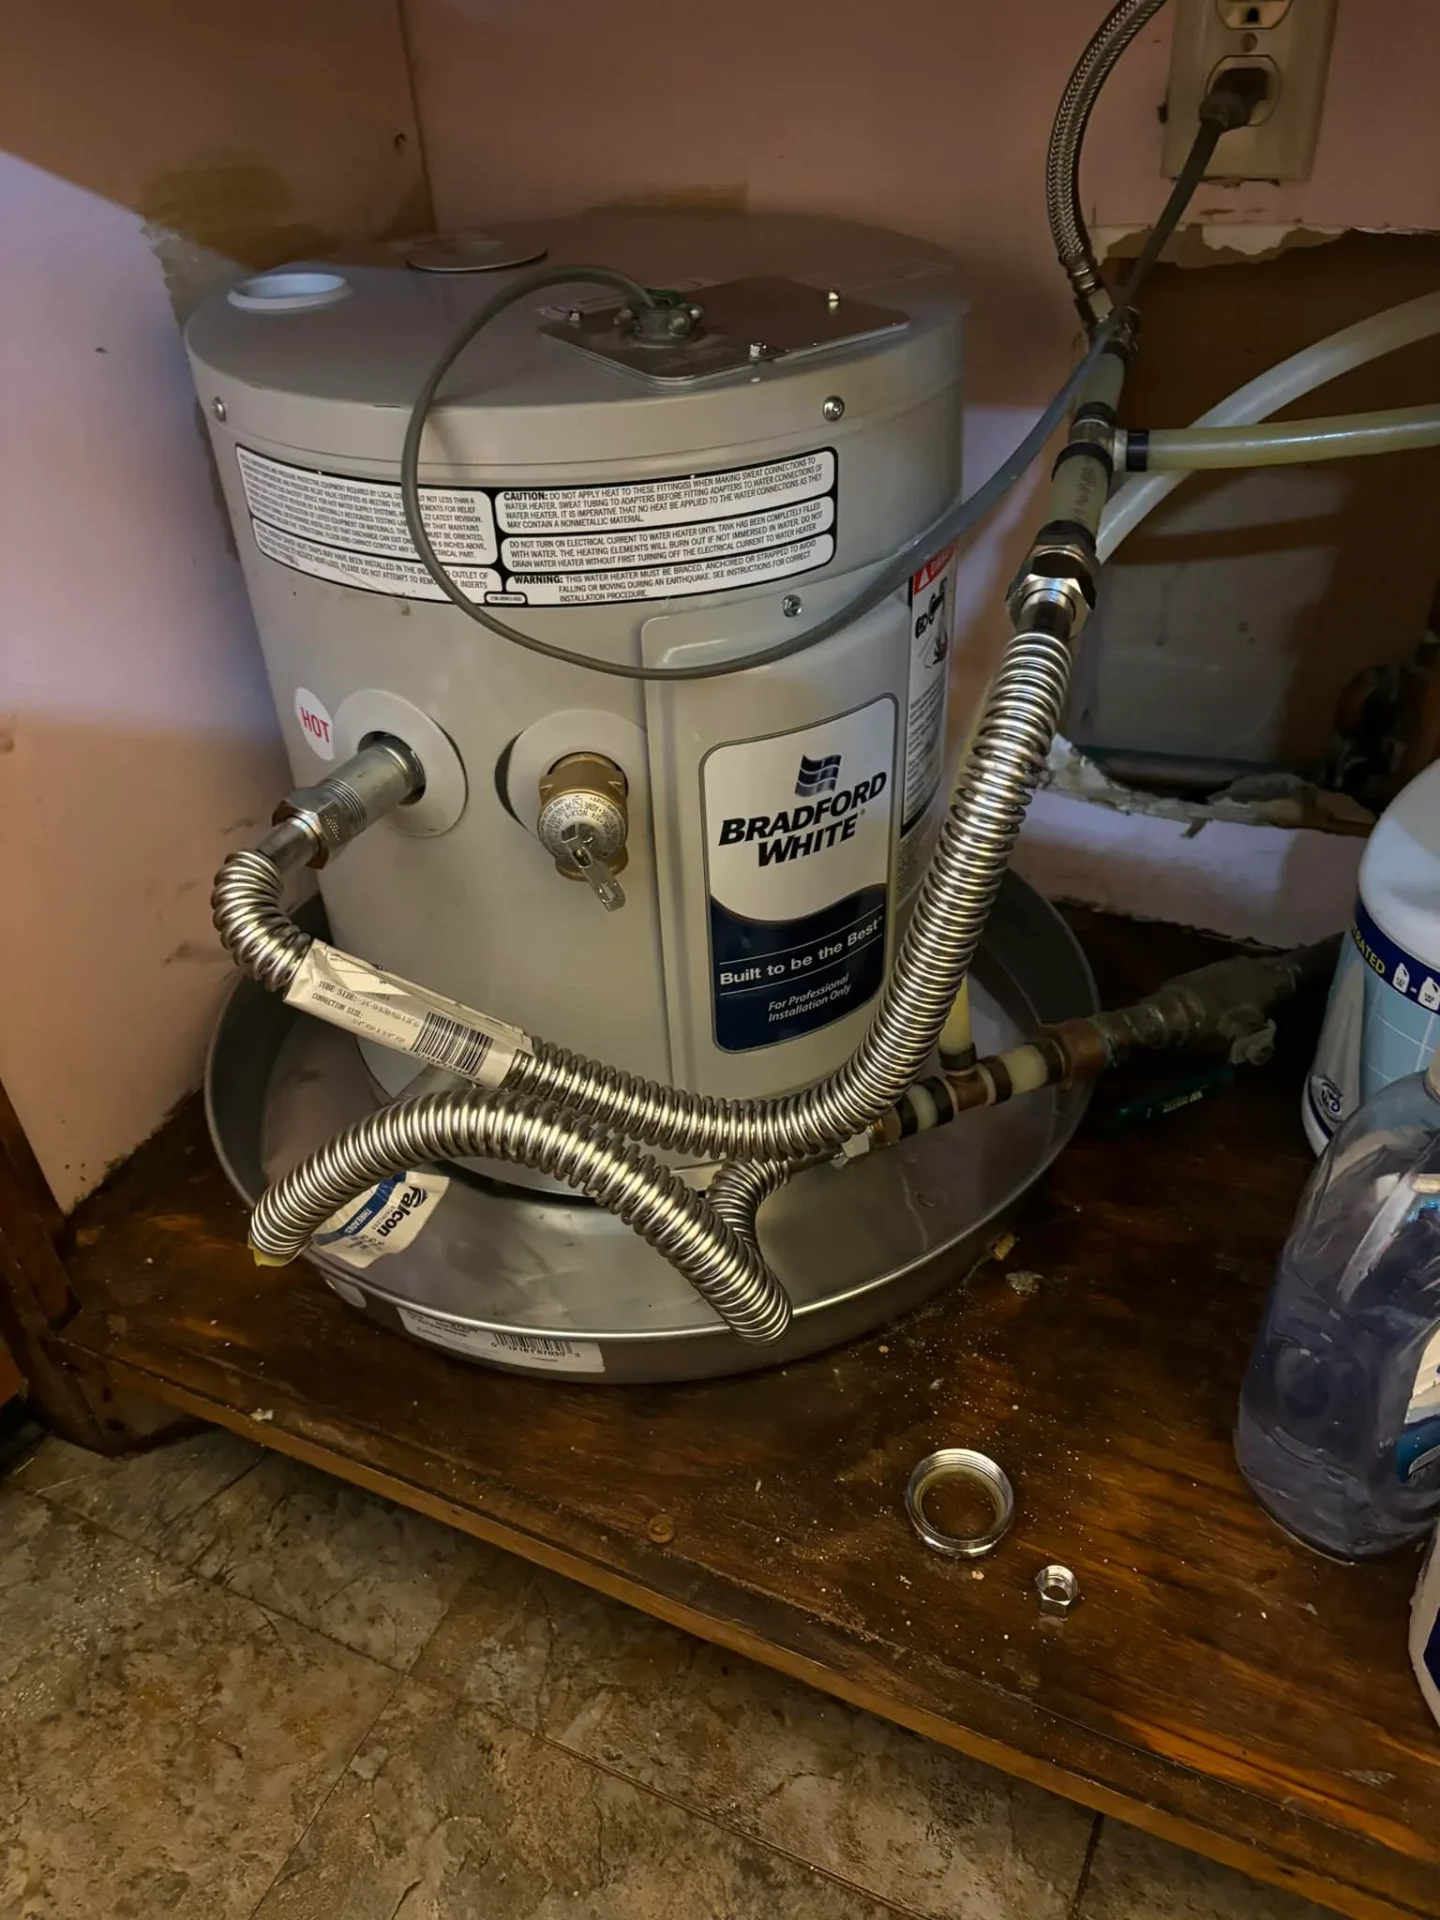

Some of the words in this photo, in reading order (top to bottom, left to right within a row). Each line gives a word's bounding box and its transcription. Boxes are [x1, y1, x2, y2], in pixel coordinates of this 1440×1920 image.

[504, 492, 548, 500] CAUTION:
[562, 492, 576, 500] NOT
[580, 490, 600, 498] APPLY
[602, 489, 619, 498] HEAT
[622, 488, 631, 496] TO
[634, 486, 654, 494] THESE
[693, 478, 714, 487] WHEN
[715, 474, 740, 485] MAKING
[742, 469, 762, 480] SWEAT
[764, 459, 808, 475] CONNECTIONS
[808, 457, 816, 466] TO
[504, 502, 528, 510] WATER
[559, 500, 580, 508] SWEAT
[583, 498, 608, 507] TUBING
[610, 498, 620, 506] TO
[621, 494, 656, 505] ADAPTERS
[657, 491, 684, 501] BEFORE
[684, 488, 708, 498] FITTING
[710, 482, 742, 496] ADAPTERS
[744, 480, 752, 488] TO
[754, 476, 774, 488] WATER
[774, 467, 814, 482] CONNECTIONS
[815, 464, 823, 472] OF
[561, 510, 567, 518] IT
[569, 510, 576, 518] IS
[578, 508, 616, 517] IMPERATIVE
[619, 506, 636, 514] THAT
[638, 504, 648, 512] NO
[650, 502, 668, 512] HEAT
[670, 500, 680, 509] BE
[680, 498, 708, 508] APPLIED
[709, 496, 718, 504] TO
[720, 494, 734, 502] THE
[734, 489, 756, 500] WATER
[756, 480, 800, 496] CONNECTIONS
[808, 474, 822, 484] THEY
[510, 540, 519, 548] DO
[521, 540, 534, 548] NOT
[536, 540, 554, 548] TURN
[567, 538, 606, 546] ELECTRICAL
[606, 535, 637, 544] CURRENT
[639, 534, 648, 542] TO
[649, 532, 670, 541] WATER
[672, 528, 697, 538] HEATER
[698, 525, 716, 535] UNTIL
[718, 522, 735, 532] TANK
[736, 520, 748, 529] HAS
[750, 516, 766, 526] BEEN
[766, 507, 802, 523] COMPLETELY
[802, 502, 821, 512] FILLED
[510, 550, 530, 558] WITH
[560, 549, 574, 557] THE
[577, 547, 608, 556] HEATING
[610, 544, 648, 554] ELEMENTS
[650, 542, 667, 550] WILL
[669, 540, 690, 548] BURN
[691, 536, 706, 546] OUT
[708, 536, 714, 544] IF
[716, 533, 730, 542] NOT
[732, 527, 768, 540] IMMERSED
[769, 524, 776, 532] IN
[801, 516, 810, 524] DO
[811, 510, 823, 520] NOT
[522, 520, 552, 528] CONTAIN
[560, 517, 608, 527] NONMETALLIC
[512, 560, 532, 568] DRAIN
[534, 560, 557, 568] WATER
[558, 559, 584, 568] HEATER
[585, 556, 616, 566] WITHOUT
[618, 554, 636, 563] FIRST
[638, 552, 667, 561] TURNING
[668, 550, 680, 558] OFF
[682, 548, 696, 556] THE
[697, 544, 734, 554] ELECTRICAL
[736, 537, 764, 548] CURRENT
[766, 534, 774, 542] TO
[775, 528, 796, 540] WATER
[514, 575, 563, 584] WARNING:
[584, 574, 608, 582] WATER
[610, 572, 638, 580] HEATER
[640, 569, 660, 578] MUST
[662, 568, 672, 576] BE
[706, 558, 744, 569] ANCHORED
[745, 556, 756, 564] OR
[756, 547, 789, 562] STRAPPED
[790, 544, 798, 552] TO
[800, 540, 816, 550] AVOID
[452, 571, 478, 579] OUTLET
[559, 584, 586, 592] FALLING
[588, 584, 598, 592] OR
[600, 581, 626, 590] MOVING
[628, 578, 653, 588] DURING
[655, 578, 664, 586] AN
[712, 570, 725, 578] SEE
[726, 560, 772, 576] INSTRUCTIONS
[772, 558, 786, 568] FOR
[786, 550, 810, 564] CORRECT
[560, 594, 605, 602] INSTALLATION
[300, 706, 329, 742] HOT
[718, 772, 887, 846] BRADFORD
[758, 814, 858, 868] WHITE
[720, 968, 762, 986] Built
[767, 964, 784, 976] to
[790, 955, 813, 970] be
[818, 942, 843, 960] the
[847, 920, 878, 946] Best
[768, 999, 786, 1012] For
[788, 972, 850, 1005] Professional
[768, 997, 828, 1022] Installation
[830, 984, 852, 1001] Only
[376, 1186, 426, 1236] Falcon
